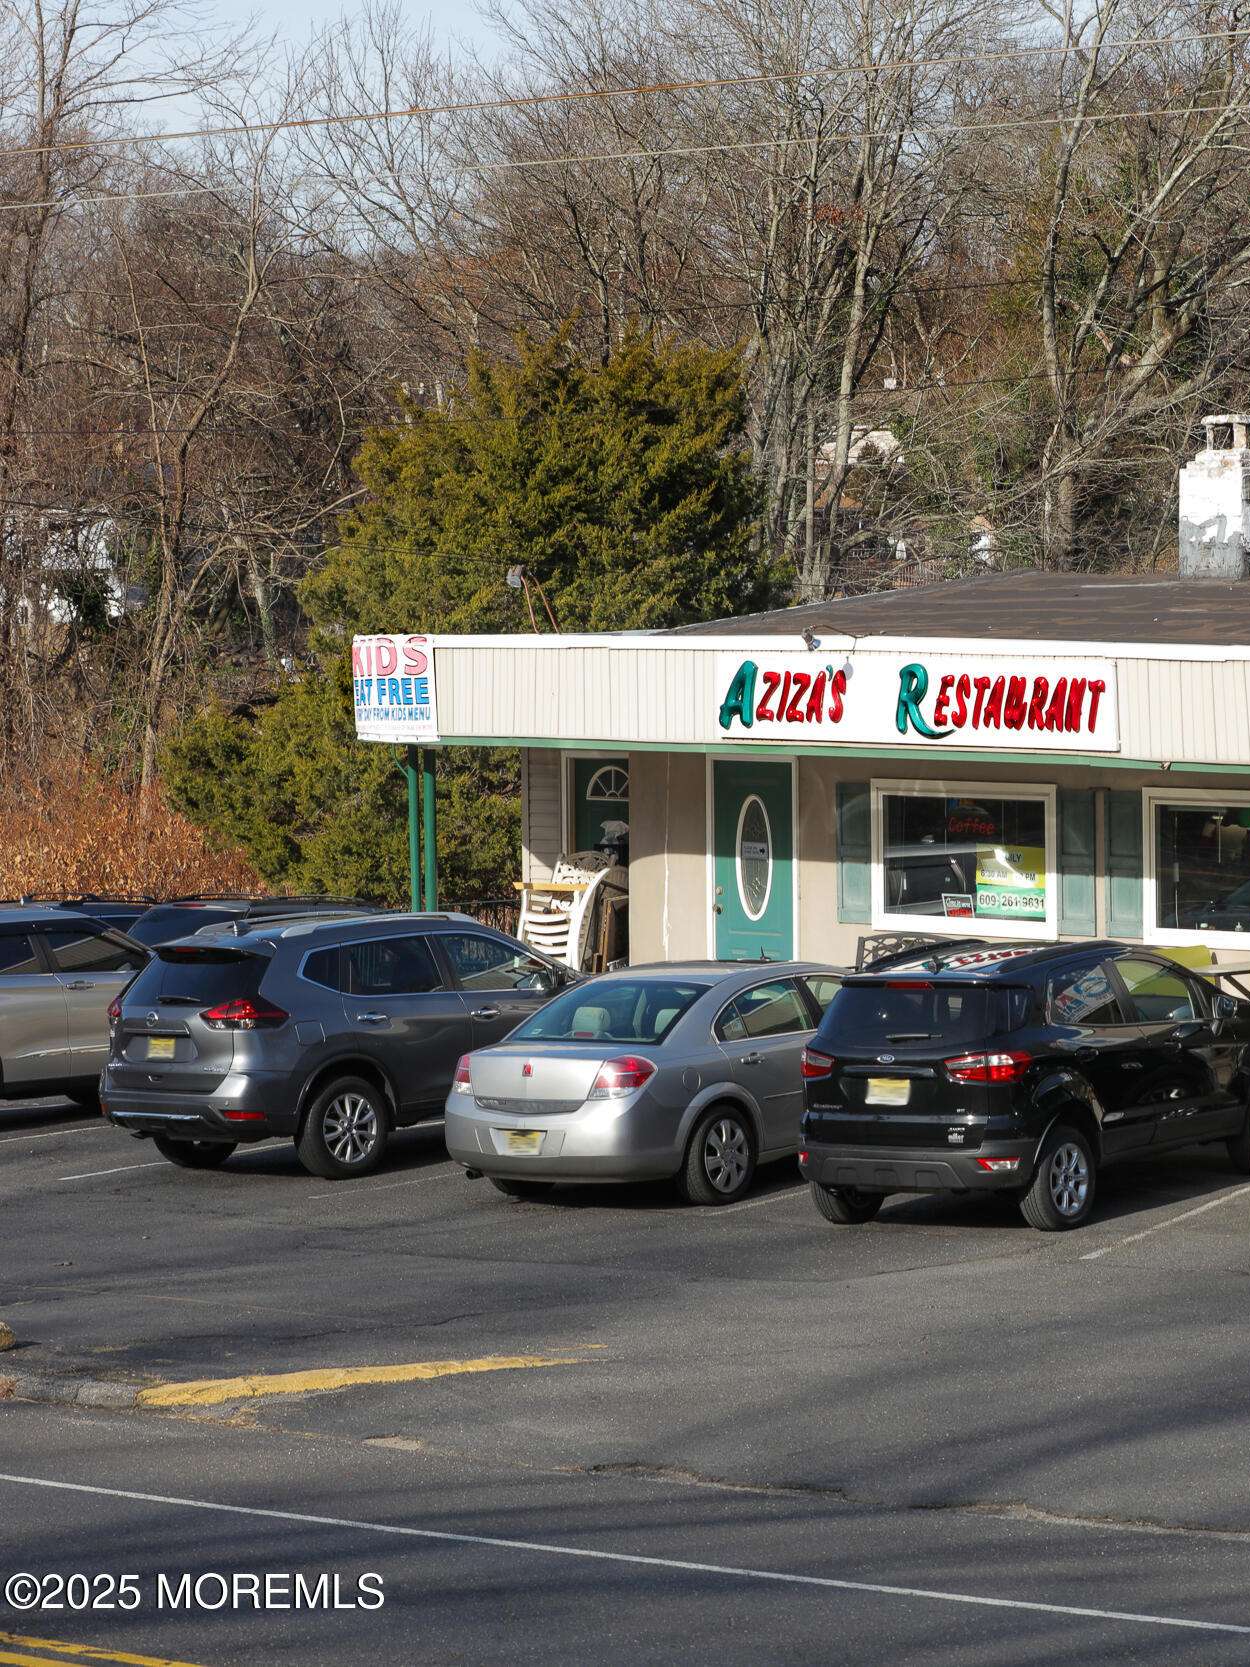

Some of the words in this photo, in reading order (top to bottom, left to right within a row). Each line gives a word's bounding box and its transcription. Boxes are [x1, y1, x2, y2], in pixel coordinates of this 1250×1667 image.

[352, 636, 428, 677] KIDS
[377, 677, 430, 705] FREE
[719, 660, 847, 730] AZIZA'S
[895, 663, 1106, 740] RESTAURANT
[392, 707, 406, 720] KIDS
[408, 707, 431, 720] MENU
[1025, 873, 1036, 881] PM
